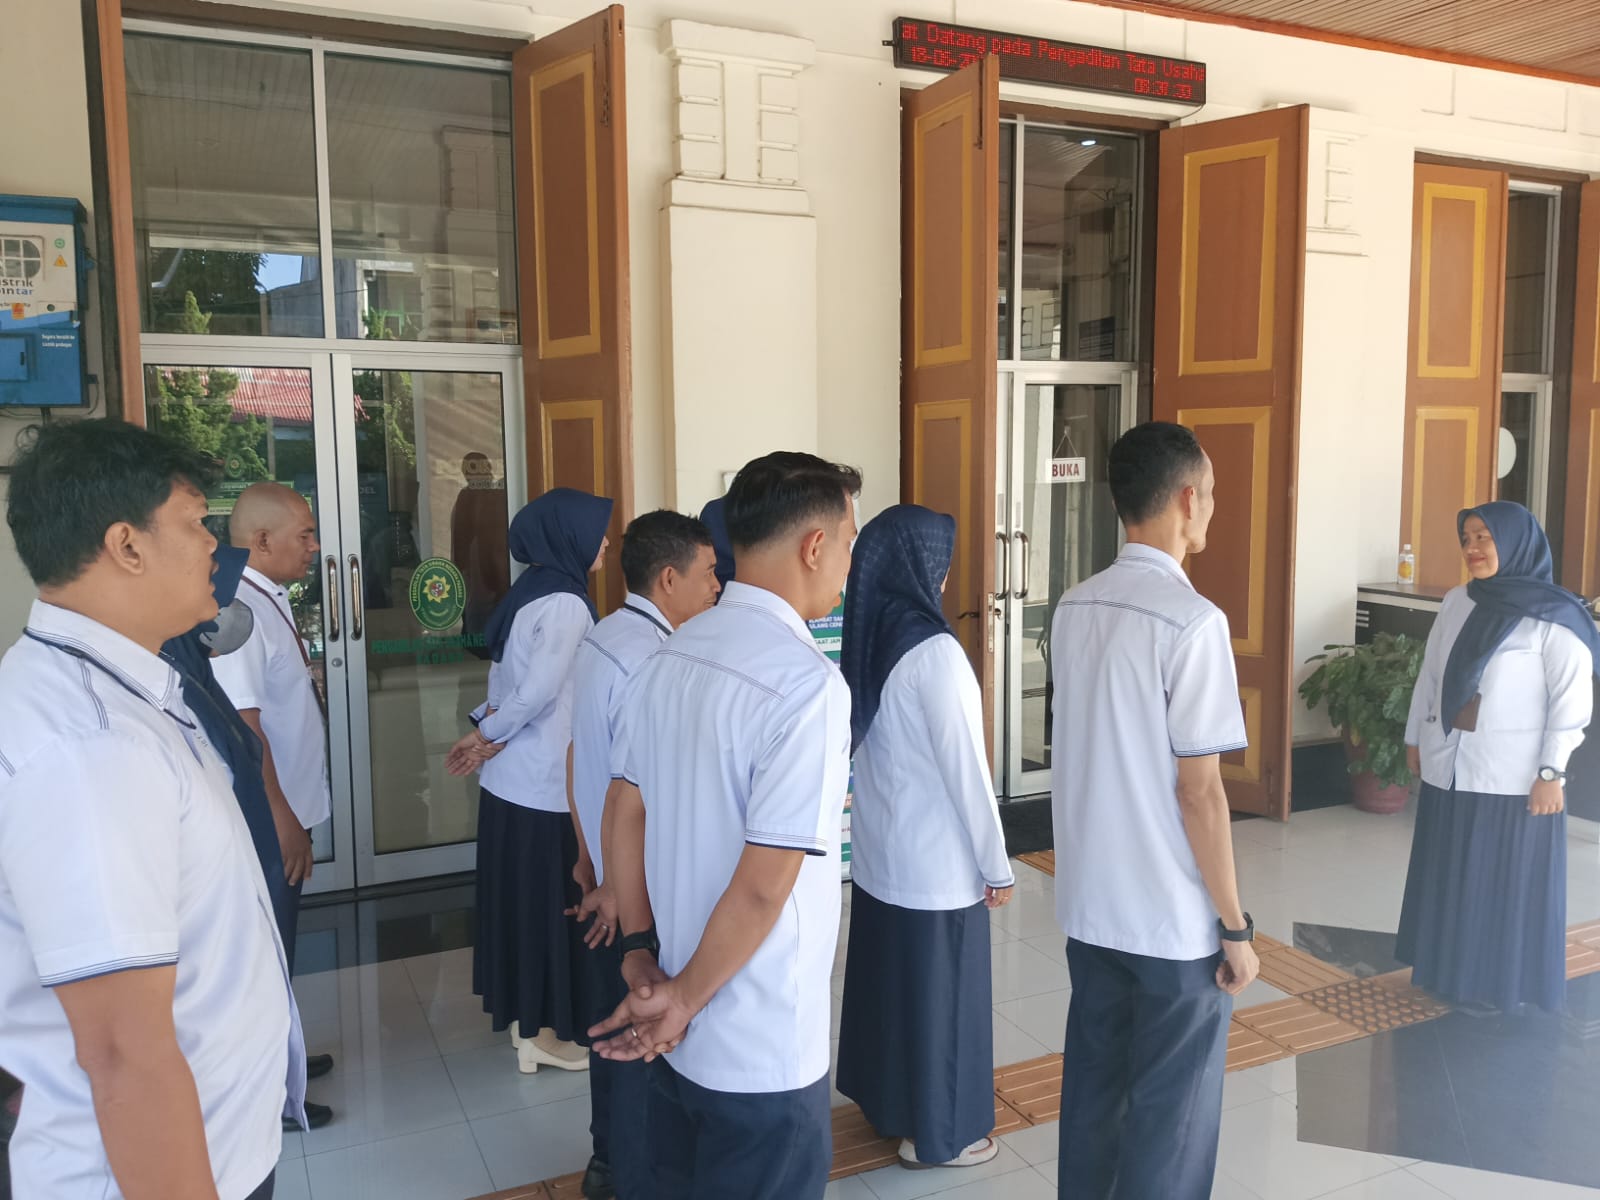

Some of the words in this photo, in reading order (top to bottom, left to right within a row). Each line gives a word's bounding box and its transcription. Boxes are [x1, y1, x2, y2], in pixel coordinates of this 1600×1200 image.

[927, 23, 986, 55] Datang
[991, 37, 1032, 57] pada
[1038, 40, 1121, 70] Pengadilan
[1125, 53, 1156, 75] Tata
[1052, 463, 1080, 477] BUKA
